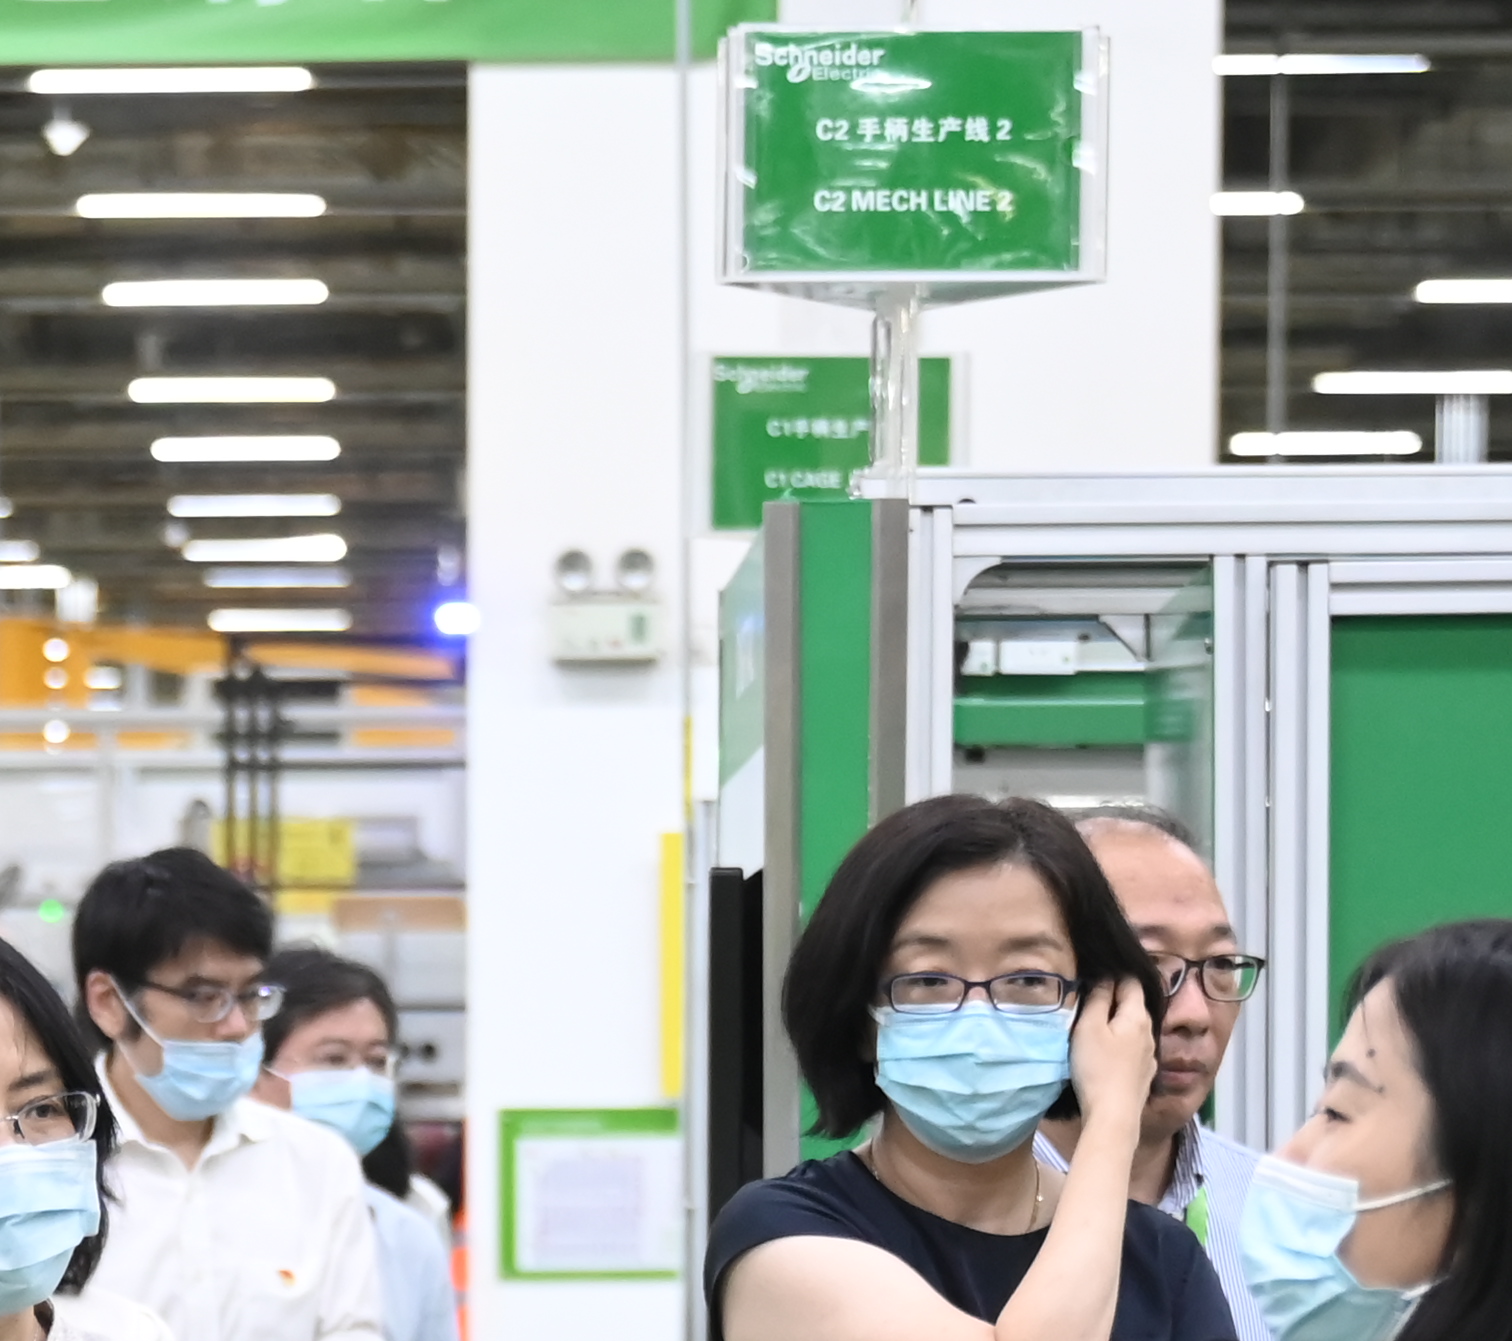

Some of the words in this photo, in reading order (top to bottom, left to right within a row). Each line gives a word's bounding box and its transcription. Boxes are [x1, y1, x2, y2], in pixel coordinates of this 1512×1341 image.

[754, 43, 885, 78] Schneider
[815, 119, 849, 141] C2
[857, 117, 991, 143] 手柄生产线
[996, 119, 1013, 141] 2
[813, 190, 846, 211] C2
[851, 190, 927, 212] MECH
[933, 190, 992, 212] LINE
[996, 190, 1014, 212] 2
